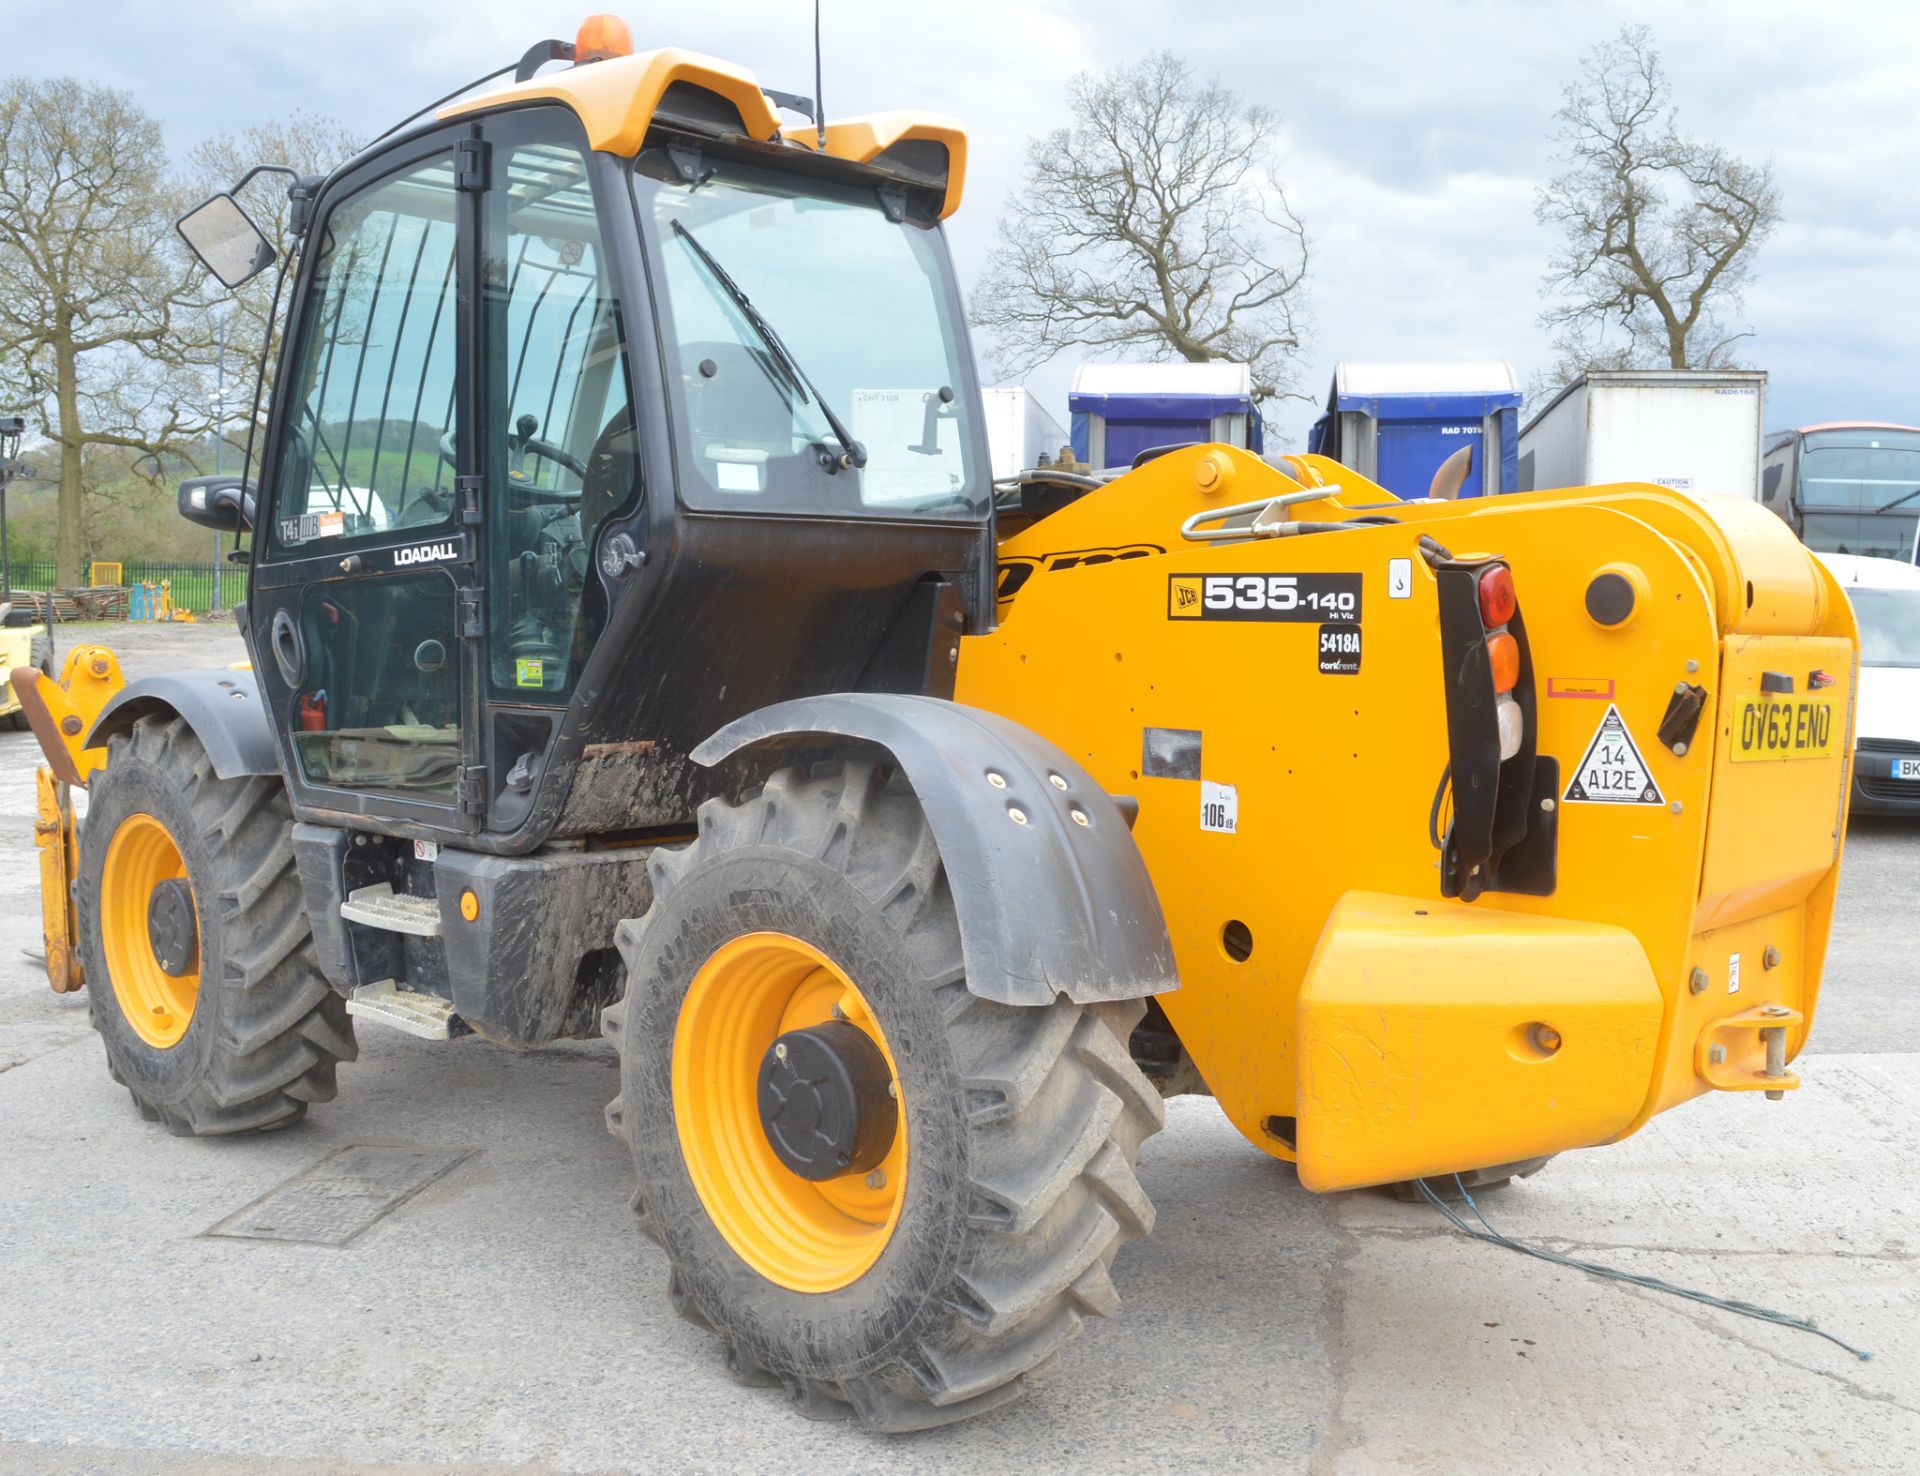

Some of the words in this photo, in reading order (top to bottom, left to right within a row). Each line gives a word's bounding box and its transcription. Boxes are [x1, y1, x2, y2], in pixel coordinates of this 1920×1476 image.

[394, 543, 458, 566] LOADALL
[1178, 585, 1198, 608] JCB
[1320, 633, 1360, 653] 5418A
[1741, 703, 1793, 751] OV63
[1601, 745, 1626, 765] 14
[1203, 803, 1224, 827] 106
[1225, 818, 1234, 829] dB
